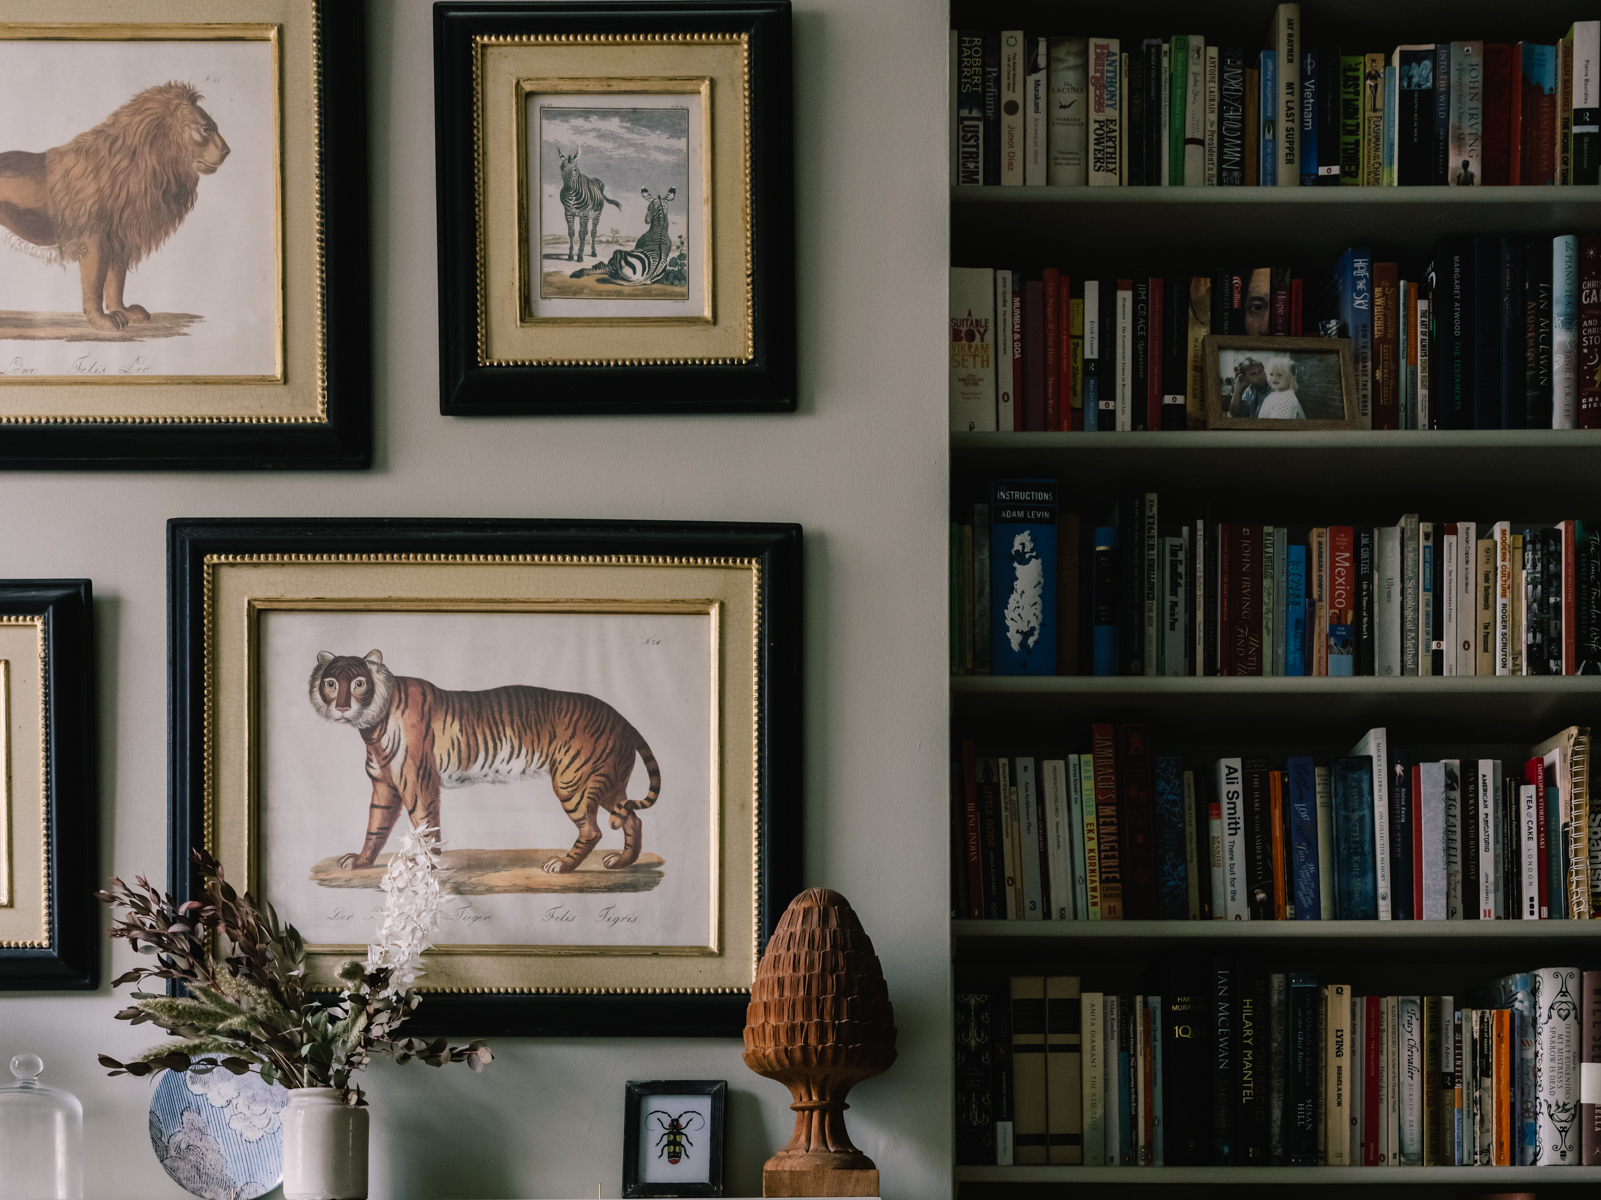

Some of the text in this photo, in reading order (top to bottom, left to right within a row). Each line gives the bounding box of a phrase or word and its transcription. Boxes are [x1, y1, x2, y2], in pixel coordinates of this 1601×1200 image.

[962, 37, 972, 93] HARRIS
[972, 37, 982, 93] ROBERT
[1091, 43, 1110, 114] Burgess
[1105, 51, 1117, 111] ANTHONY
[986, 67, 998, 120] Perfume
[1208, 86, 1216, 114] LAURAIN
[1285, 18, 1295, 165] JAY RAYNER MY LAST SUPPER
[1303, 79, 1315, 130] Vietnam
[1468, 62, 1479, 159] JOHN IRVING
[1007, 125, 1016, 149] Junot
[1094, 119, 1105, 172] POWERS
[1106, 119, 1117, 175] EARTHLY
[1538, 97, 1550, 171] SHANTARAM
[1353, 259, 1369, 278] HALF
[1353, 292, 1369, 310] SKY
[1565, 255, 1573, 333] PIANO TEACHER
[951, 318, 989, 328] SUITABLE
[1013, 297, 1021, 331] MUMBAI
[952, 328, 989, 343] BOY
[952, 343, 989, 353] VIKRAM
[1013, 342, 1021, 359] GOA
[66, 352, 107, 375] Felis
[951, 353, 990, 369] SETH
[997, 491, 1053, 501] INSTRUCTIONS
[1001, 510, 1050, 519] ADAM LEVIN
[1169, 543, 1182, 631] The Godfather Mario Puzo
[1240, 540, 1250, 619] JOHN IRVING
[1334, 552, 1349, 608] Mexico
[1384, 578, 1393, 603] Ulysses
[1407, 568, 1414, 576] of
[1405, 580, 1415, 629] Sociological
[1407, 632, 1415, 668] Method
[1225, 765, 1239, 785] Ali
[1095, 734, 1120, 880] JAMRACH'S MENAGERIE
[1226, 790, 1240, 837] Smith
[967, 802, 978, 861] BEING INDIAN
[1083, 760, 1099, 907] MAN TIGER EKA KURNIAWAN
[1228, 840, 1236, 861] There
[542, 902, 577, 923] Felis
[1402, 1008, 1419, 1036] Tracy
[1557, 1033, 1563, 1046] MY
[1242, 999, 1253, 1103] HILARY MANTEL
[1407, 1038, 1420, 1081] Chevalier
[1549, 1065, 1556, 1073] IS
